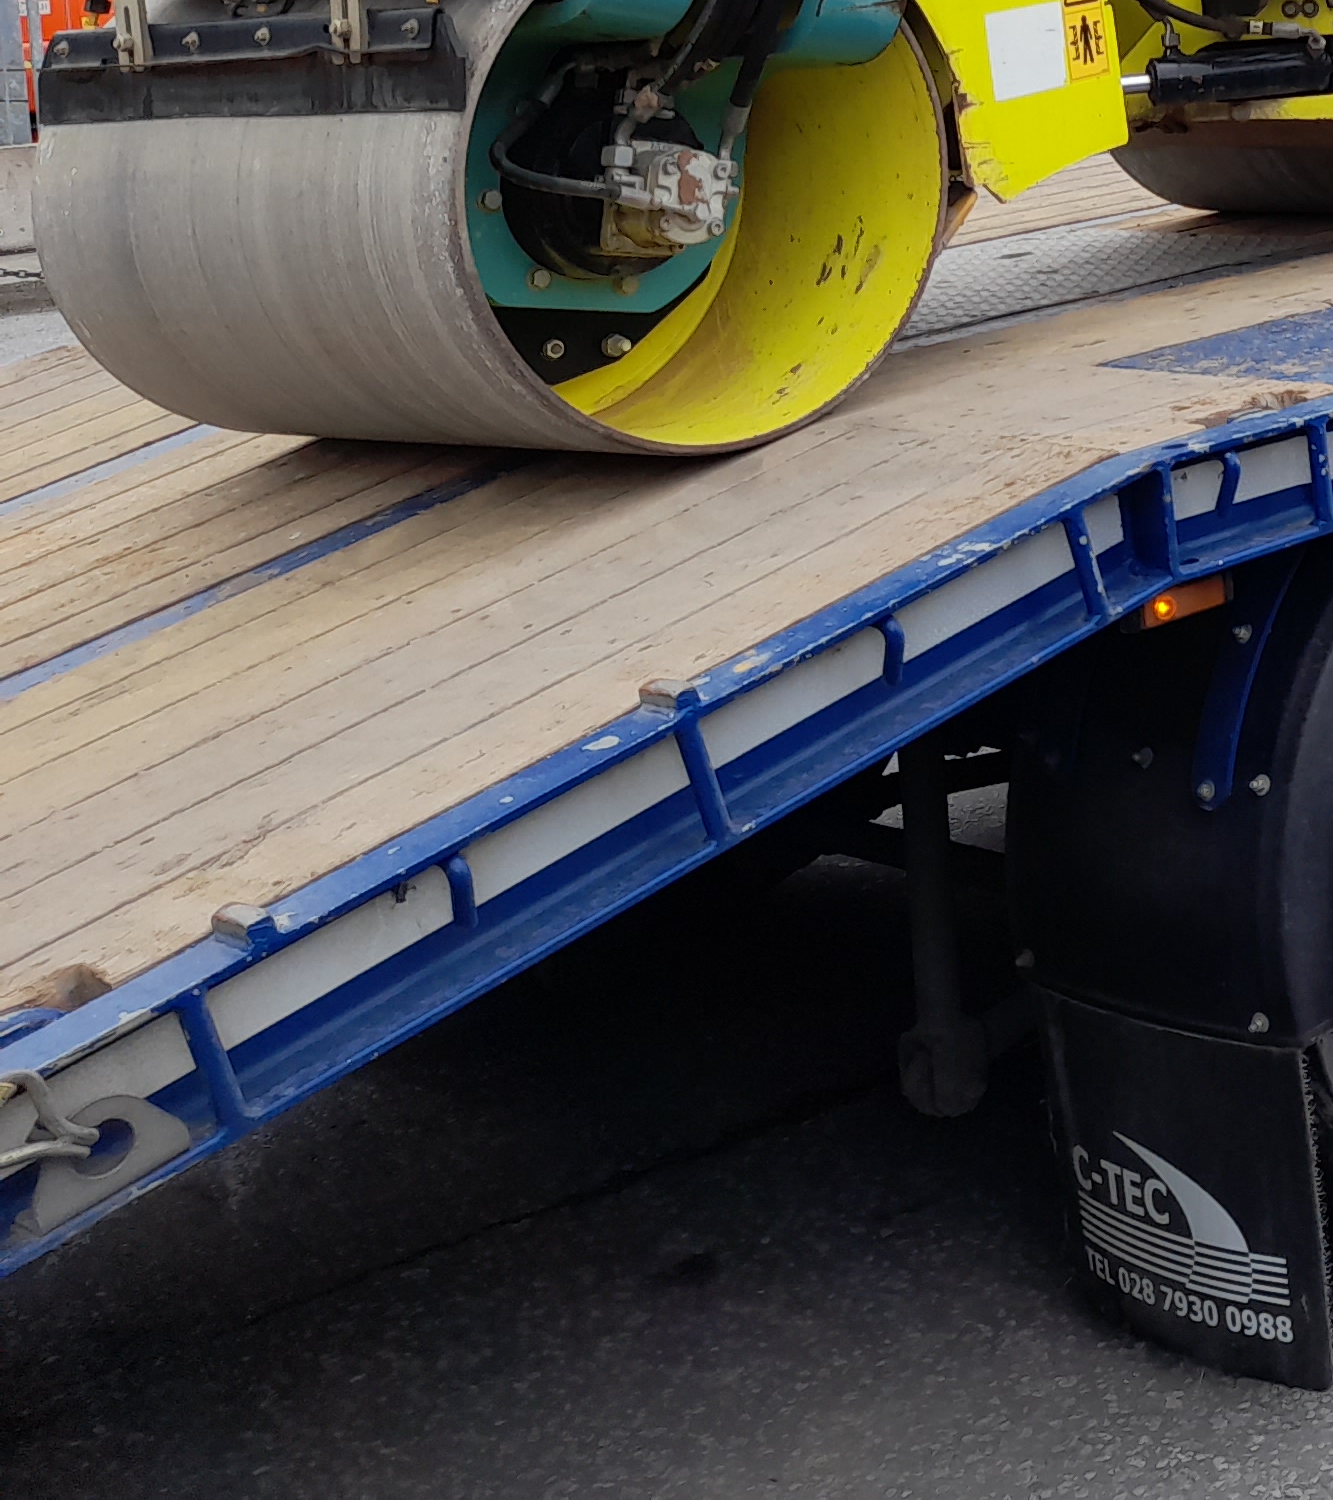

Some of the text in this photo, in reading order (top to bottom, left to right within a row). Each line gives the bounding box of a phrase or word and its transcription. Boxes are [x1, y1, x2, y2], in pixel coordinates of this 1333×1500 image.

[1072, 1144, 1171, 1226] C-TEC
[1086, 1245, 1295, 1344] TEL 028 7930 0988
